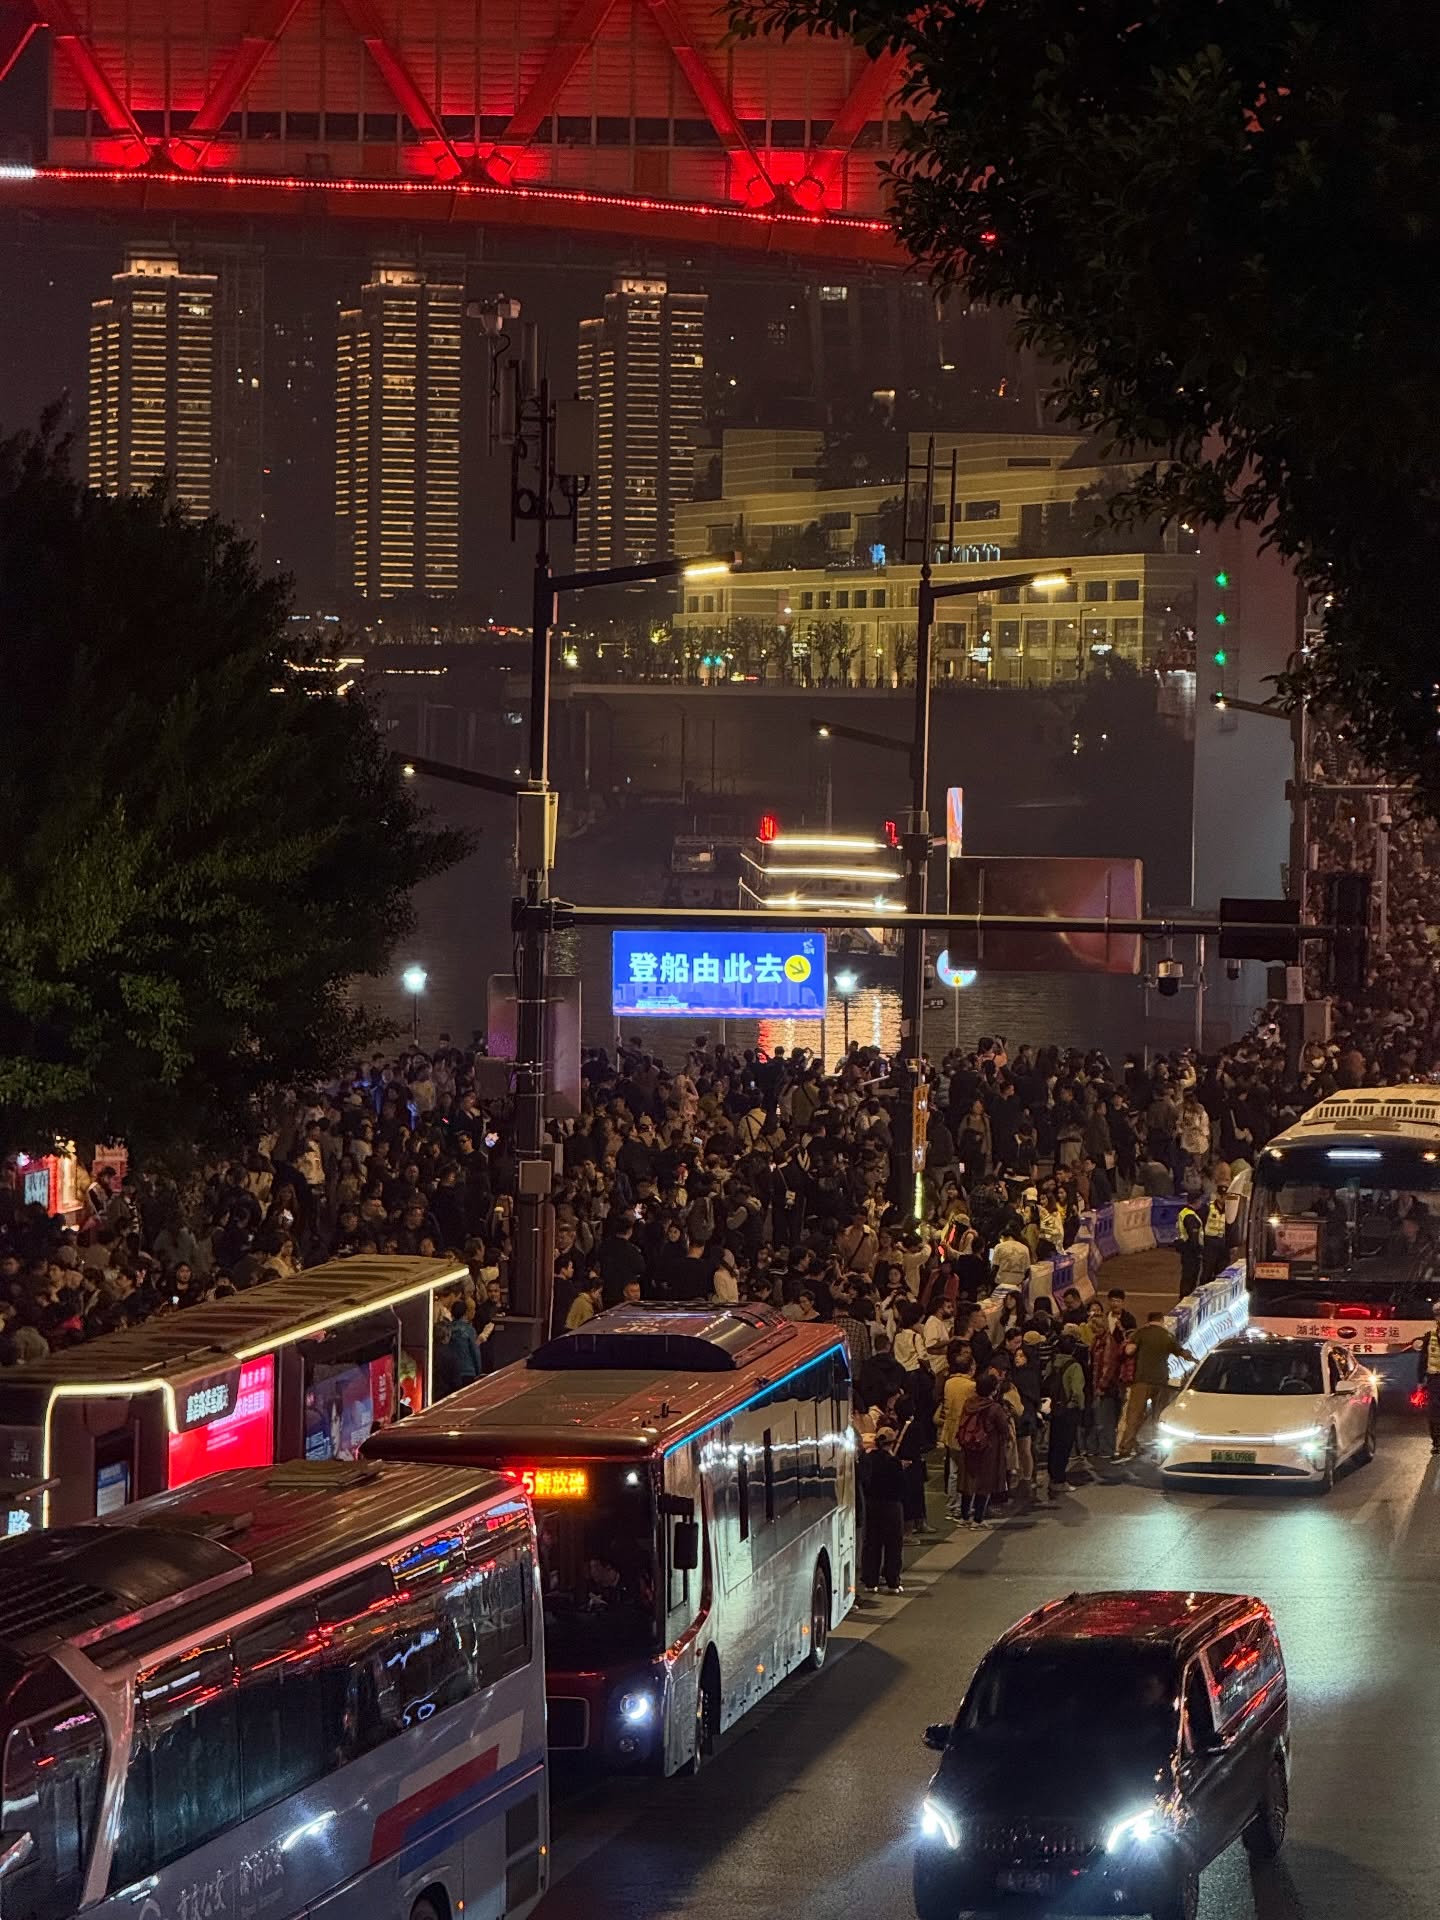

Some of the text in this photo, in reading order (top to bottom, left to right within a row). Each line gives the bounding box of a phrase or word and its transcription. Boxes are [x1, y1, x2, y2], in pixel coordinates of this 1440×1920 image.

[629, 952, 784, 984] 登船由此去
